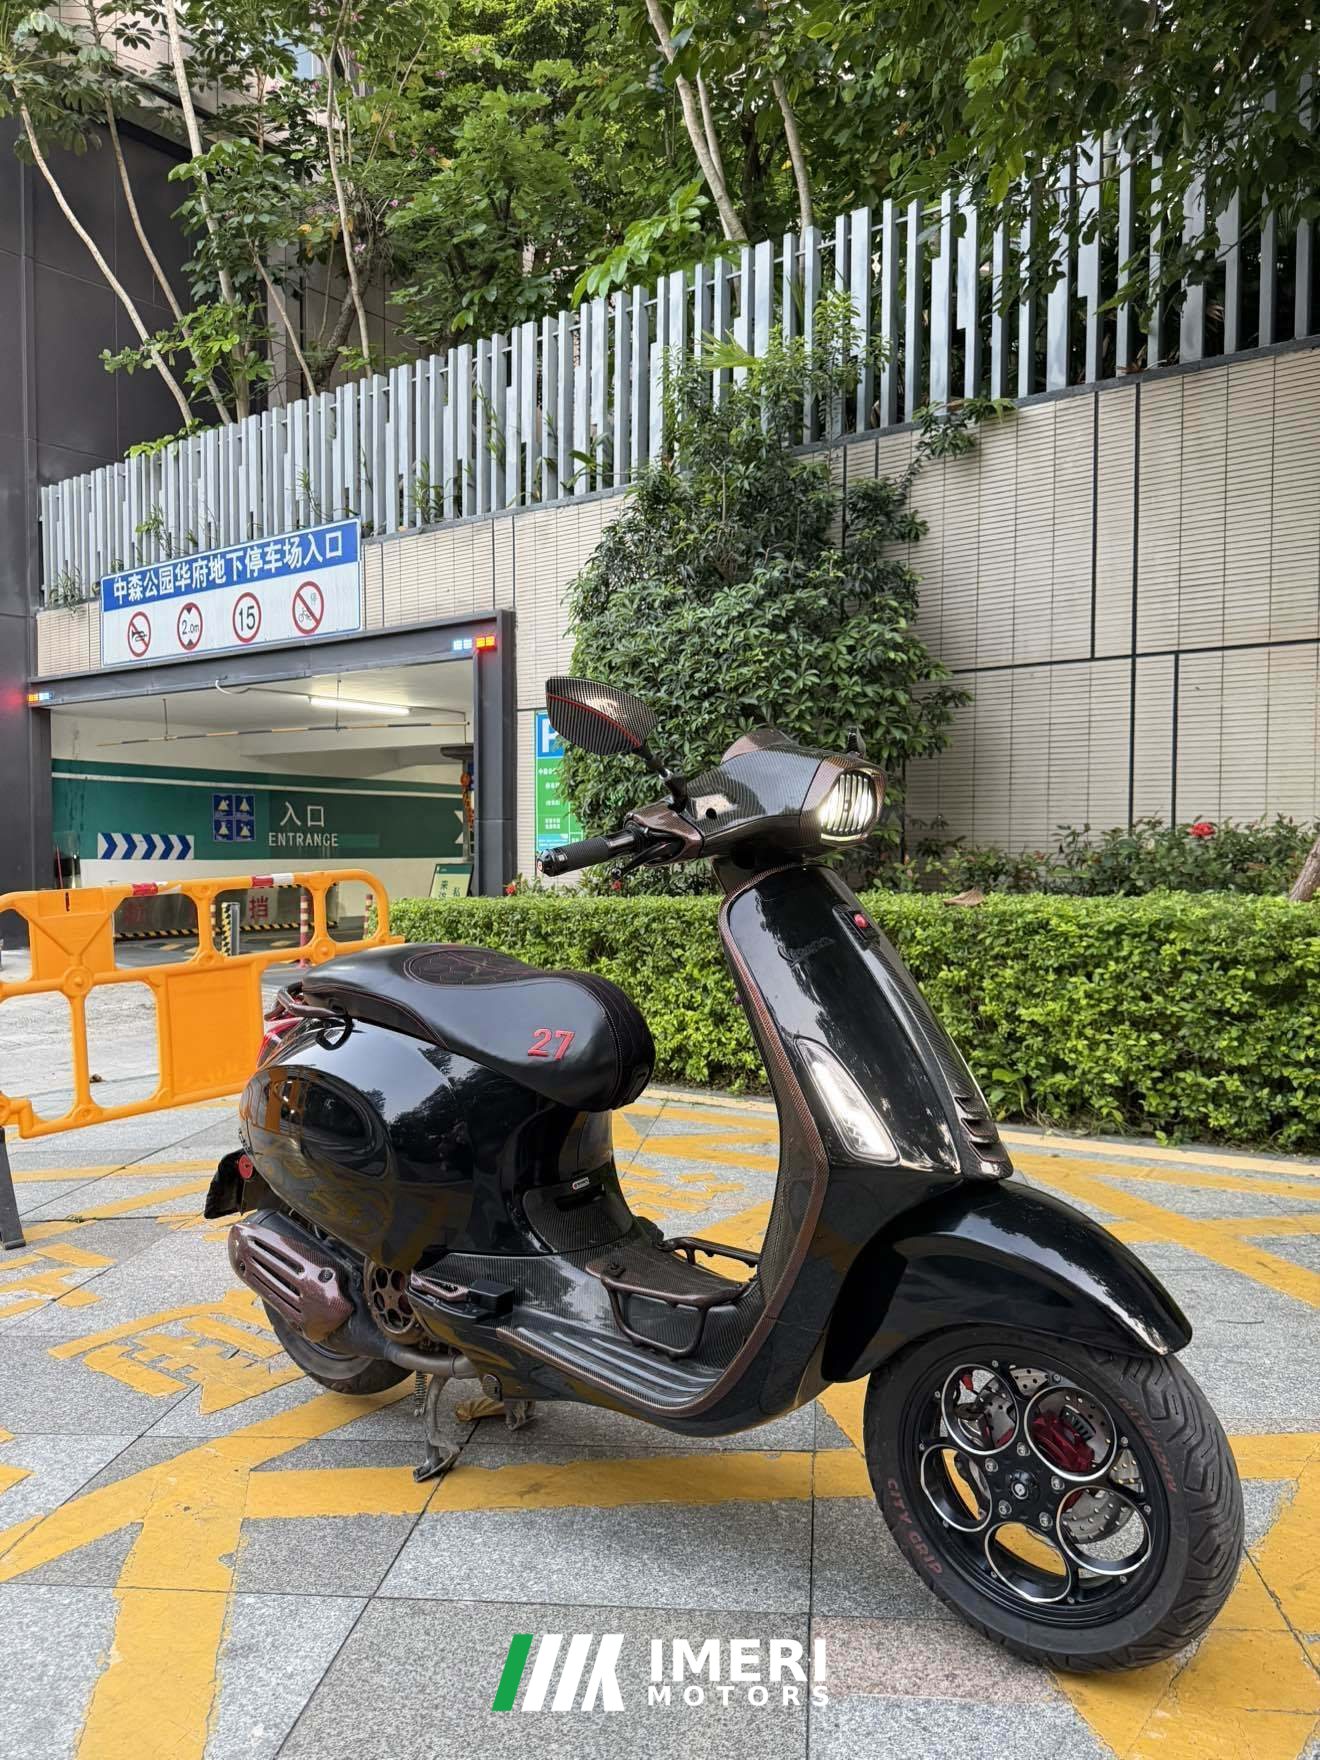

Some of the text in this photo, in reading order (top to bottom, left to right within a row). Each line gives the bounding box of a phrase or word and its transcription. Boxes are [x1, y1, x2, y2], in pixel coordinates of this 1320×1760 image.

[113, 531, 342, 605] 中森公园华府地下停车场入口
[181, 619, 199, 635] 2.0m
[238, 605, 256, 631] 15
[280, 801, 325, 827] 入口
[268, 832, 339, 847] ENTRANCE
[527, 1027, 576, 1060] 27
